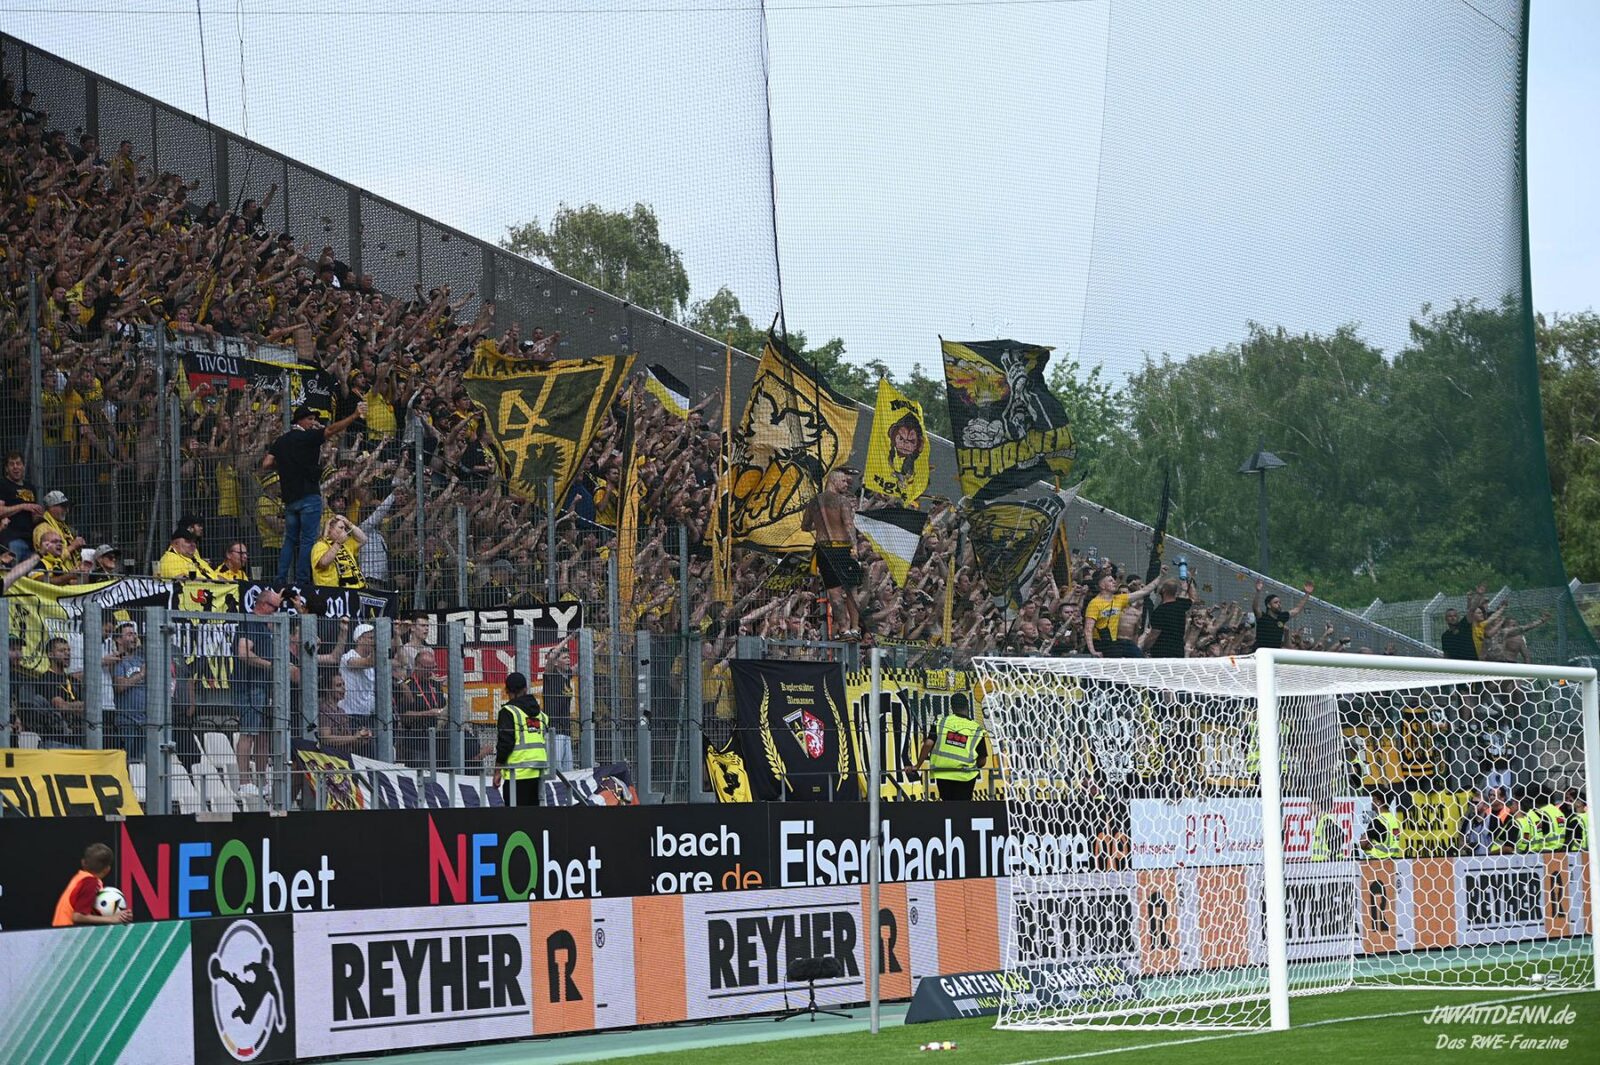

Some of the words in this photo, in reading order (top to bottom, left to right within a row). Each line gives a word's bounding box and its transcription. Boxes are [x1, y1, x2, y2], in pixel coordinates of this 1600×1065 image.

[196, 353, 239, 375] TIVOLI
[650, 825, 741, 857] bach
[780, 818, 966, 888] Eisenbach
[651, 870, 713, 894] ore
[1465, 872, 1544, 926] REYHER
[708, 909, 860, 991] REYHER
[331, 933, 526, 1022] REYHER
